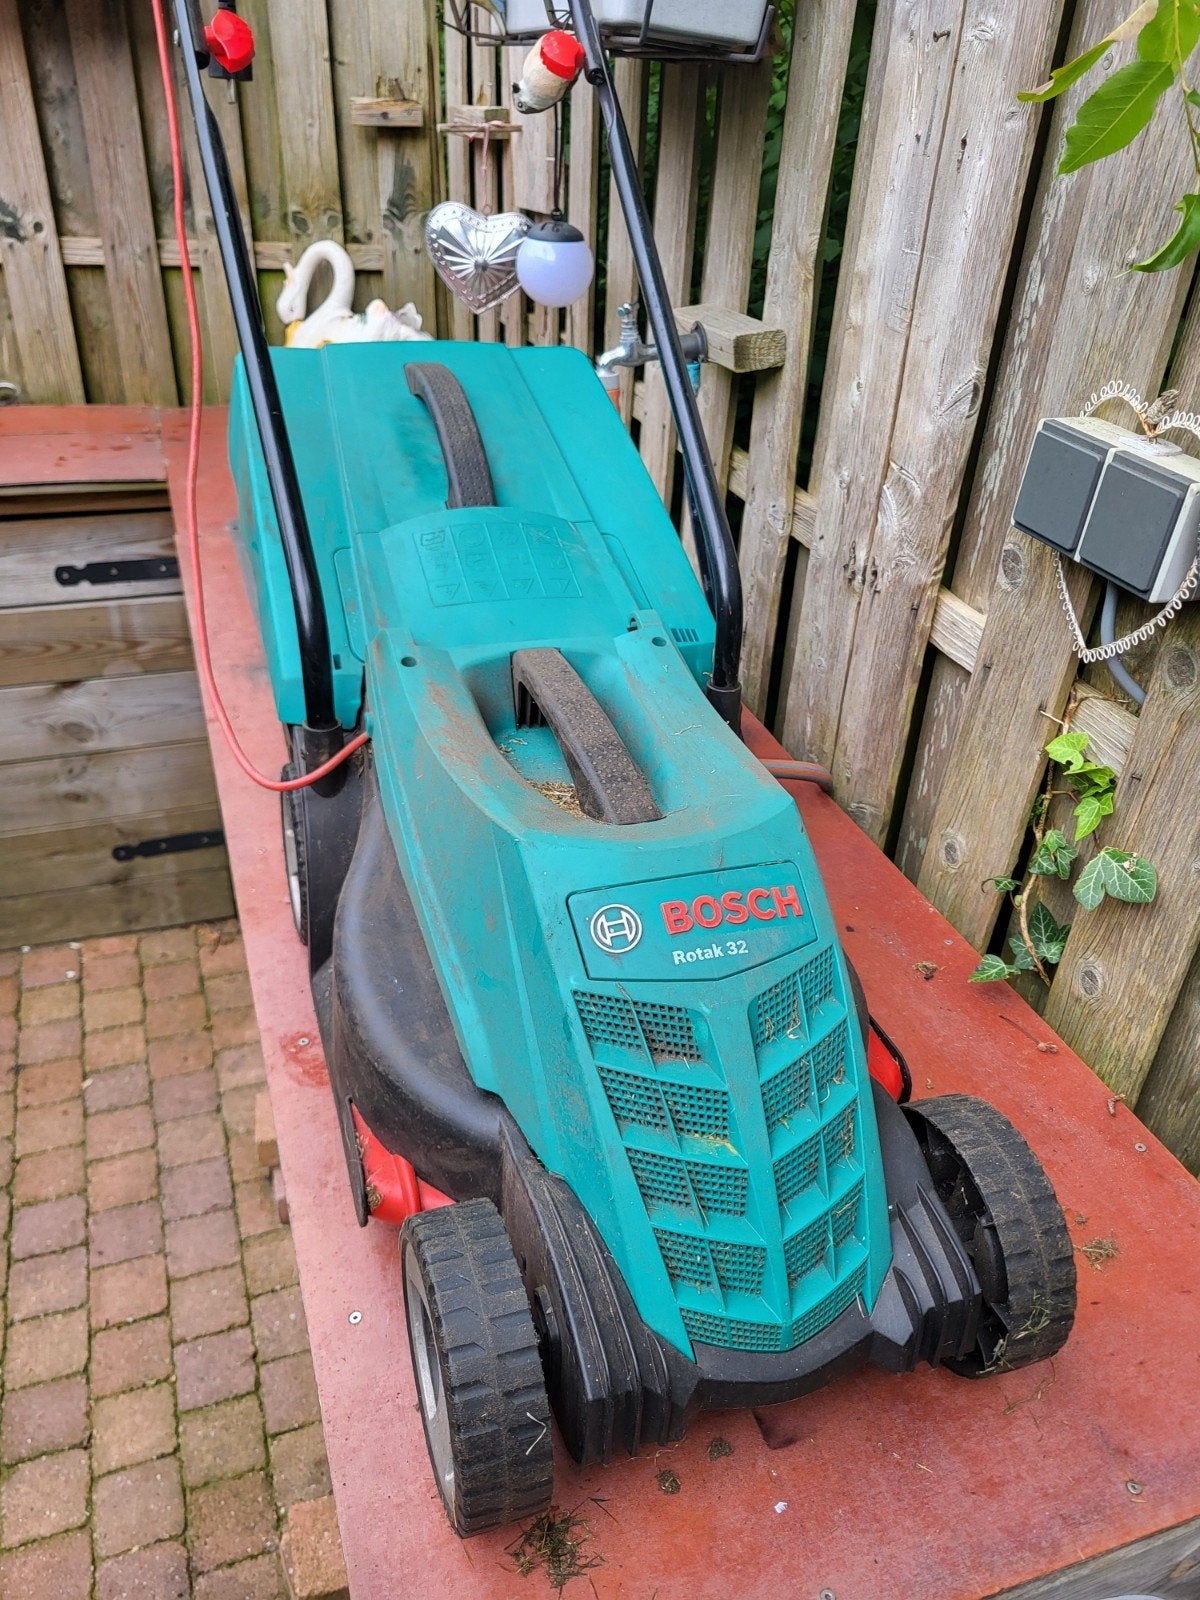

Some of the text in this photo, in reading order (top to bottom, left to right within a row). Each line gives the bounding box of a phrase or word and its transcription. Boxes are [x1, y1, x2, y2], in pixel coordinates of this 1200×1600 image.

[660, 885, 803, 935] BOSCH
[672, 940, 749, 965] Rotak 32
